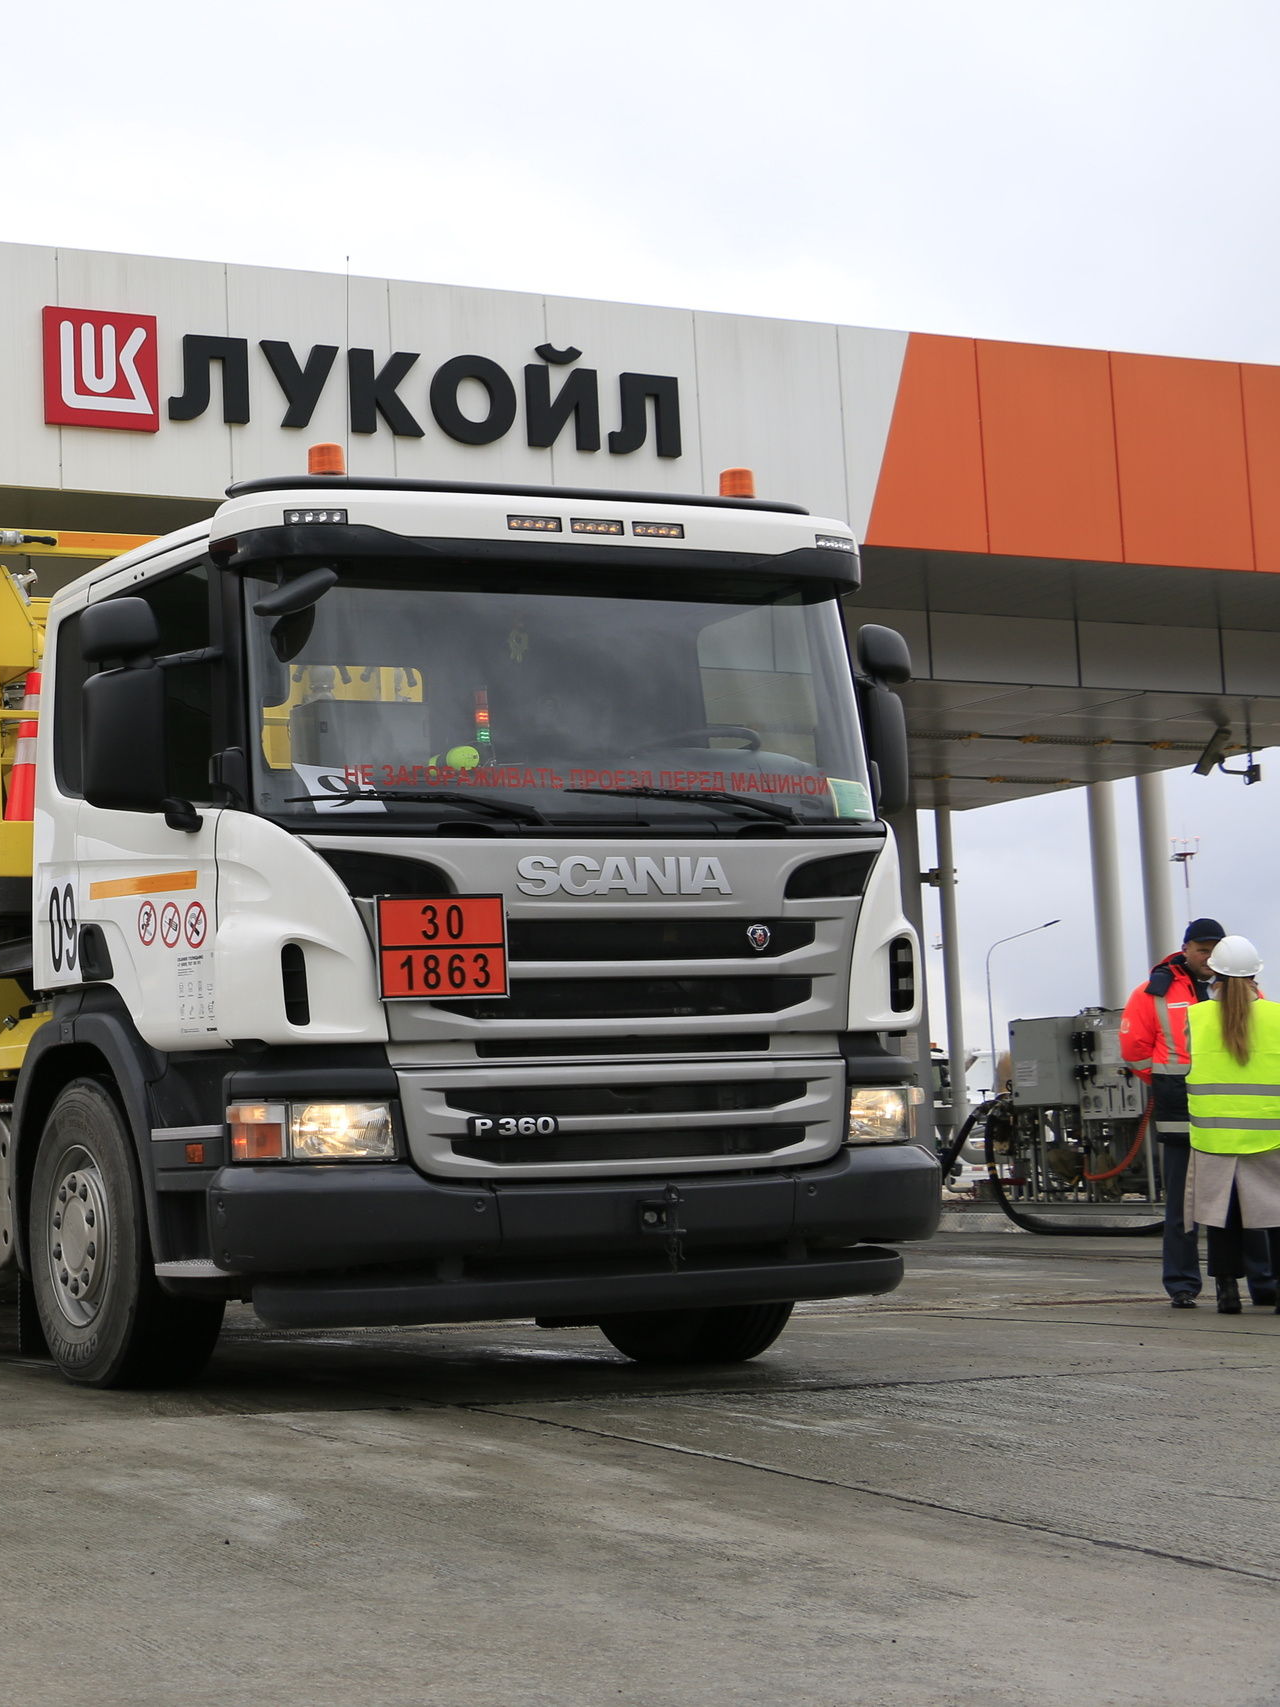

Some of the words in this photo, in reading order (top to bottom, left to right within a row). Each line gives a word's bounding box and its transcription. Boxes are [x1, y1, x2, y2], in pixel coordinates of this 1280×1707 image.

[168, 334, 682, 459] ЛУКОЙЛ
[344, 764, 374, 786] НЕ
[381, 764, 564, 790] ЗАГОРАЖИВАТЬ
[659, 770, 726, 792] ПЕРЕД
[731, 772, 830, 796] МАШИНОЙ
[517, 855, 733, 897] SCANIA
[49, 883, 78, 973] 09
[420, 904, 464, 941] 30
[399, 953, 491, 991] 1863
[475, 1118, 493, 1137] P
[499, 1116, 555, 1136] 360
